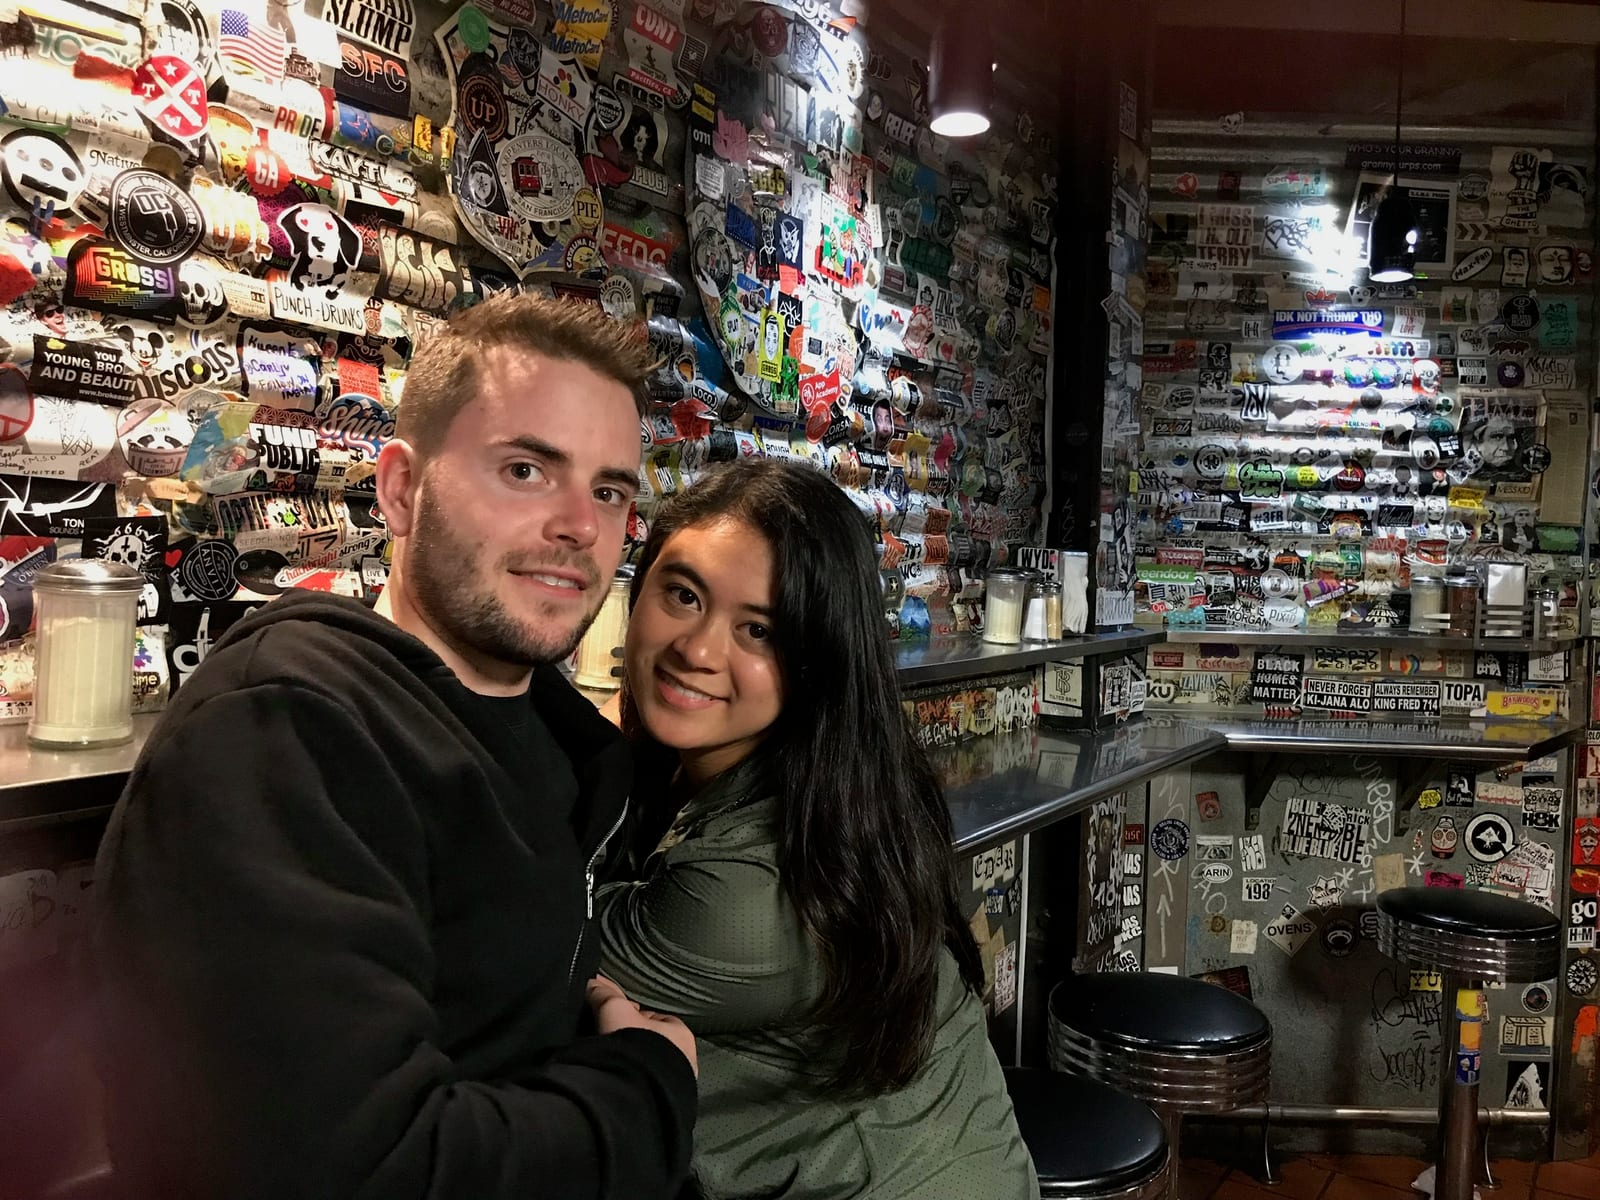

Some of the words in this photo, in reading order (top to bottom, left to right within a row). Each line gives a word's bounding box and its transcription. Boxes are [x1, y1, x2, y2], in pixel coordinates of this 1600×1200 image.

[510, 4, 530, 18] DELAY
[326, 0, 411, 54] SLUMP
[635, 4, 678, 44] CUNT
[340, 42, 407, 93] SFC
[471, 96, 498, 122] UP
[537, 80, 584, 122] HONKY
[274, 106, 322, 139] PRIDE
[500, 139, 544, 179] CARPENTERS
[1414, 146, 1462, 158] GRANNY?
[1361, 159, 1441, 171] grannyurps.com
[533, 199, 572, 217] FRANCISCO
[577, 200, 599, 219] PIE
[152, 234, 191, 258] CALIFORNIA
[566, 237, 587, 268] CATALINA
[95, 255, 169, 290] GROSS
[1454, 250, 1490, 280] Max-Fan
[1275, 311, 1294, 322] IDK
[1297, 311, 1318, 322] NOT
[1319, 311, 1357, 322] TRUMP
[1361, 311, 1382, 324] THO
[43, 351, 94, 371] YOUNG,
[96, 360, 125, 376] BRO
[94, 351, 117, 363] YOU
[40, 366, 77, 382] AND
[80, 372, 136, 393] BEAUTI
[815, 381, 826, 390] App
[815, 387, 839, 399] Academy
[320, 403, 395, 439] Shine
[249, 422, 318, 450] FUND
[765, 443, 790, 455] ROUGH
[256, 443, 320, 475] PUBLIC
[23, 468, 65, 476] UNITED
[201, 547, 224, 596] ANVIL
[366, 570, 380, 578] LIVE
[1226, 610, 1269, 627] MORGAN
[1257, 657, 1301, 672] BLACK
[1253, 685, 1297, 700] MATTER
[1309, 680, 1336, 694] NEVER
[1338, 683, 1370, 697] FORGET
[1375, 684, 1401, 696] ALWAYS
[1402, 685, 1438, 697] REMEMBER
[1445, 683, 1481, 702] TOPA
[1306, 693, 1347, 708] KI-JANA
[1350, 698, 1370, 710] ALO
[1374, 698, 1396, 710] KING
[1398, 698, 1421, 710] FRED
[1422, 699, 1438, 711] 714
[1289, 797, 1321, 816] BLUE
[1246, 884, 1275, 900] 198
[1571, 900, 1597, 924] go
[1267, 922, 1311, 936] OVENS
